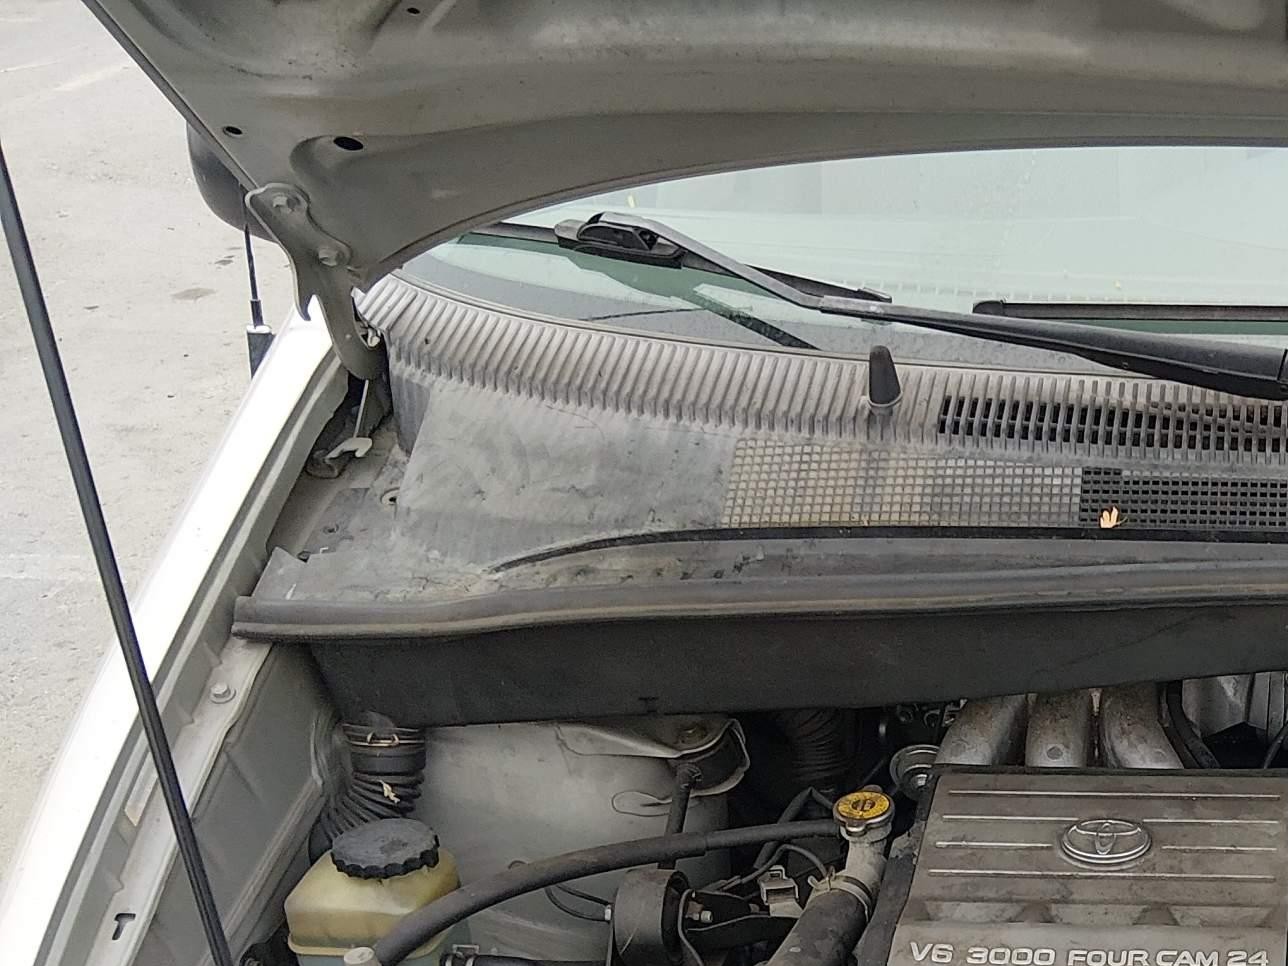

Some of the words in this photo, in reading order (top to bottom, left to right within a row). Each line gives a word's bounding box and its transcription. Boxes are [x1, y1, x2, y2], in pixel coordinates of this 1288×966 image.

[910, 941, 954, 963] V6
[966, 947, 1056, 966] 3000
[1067, 949, 1150, 966] FOUR
